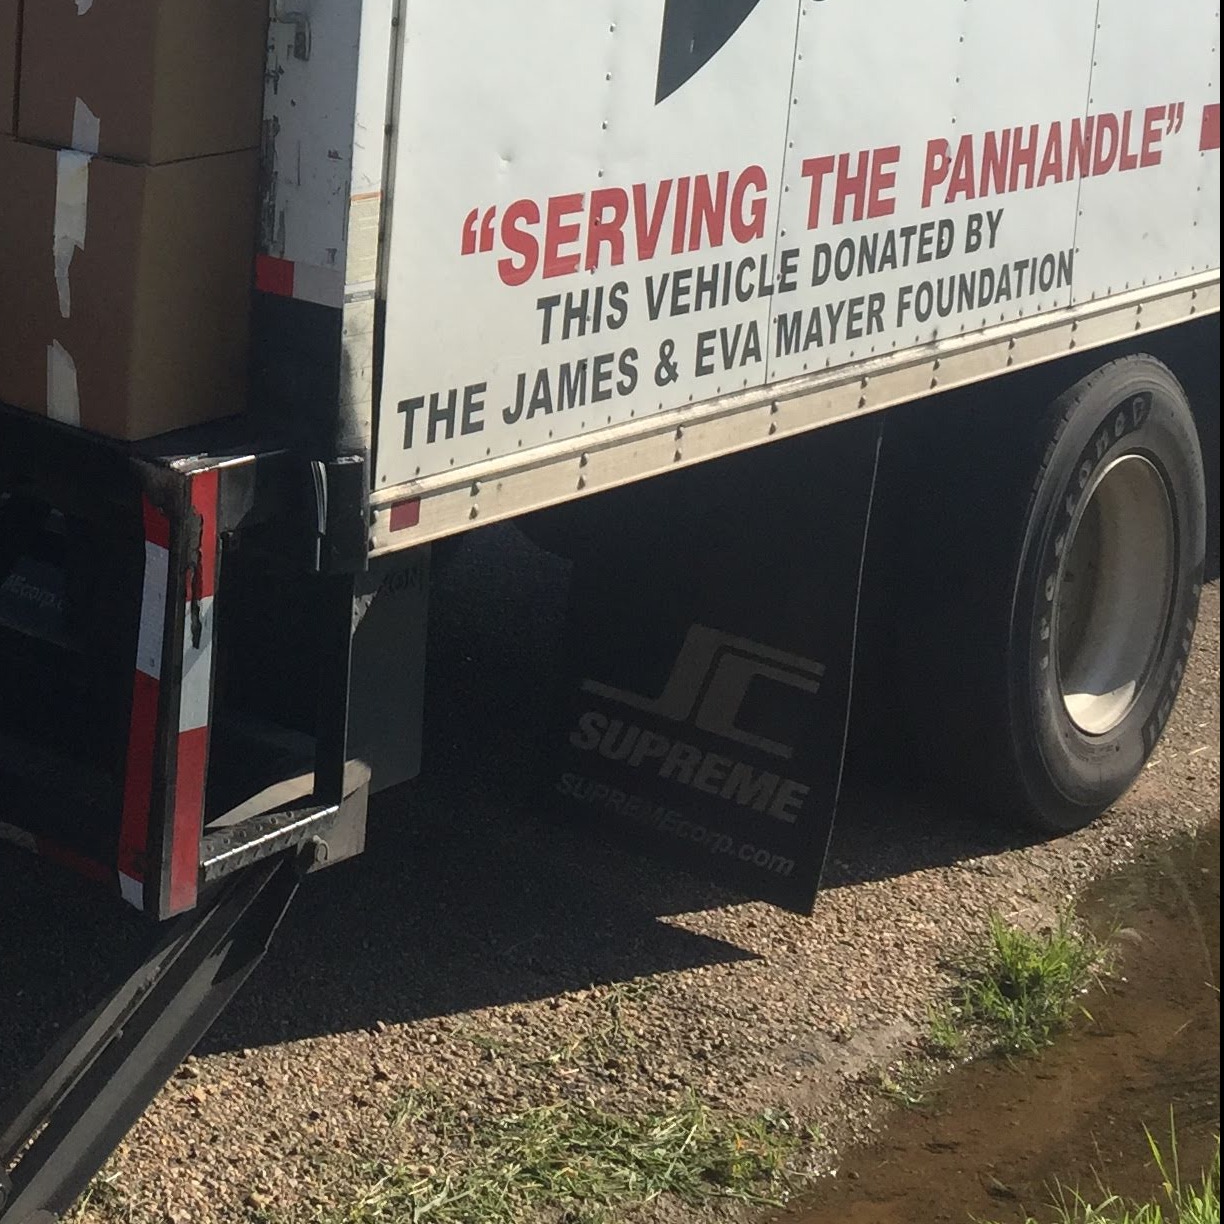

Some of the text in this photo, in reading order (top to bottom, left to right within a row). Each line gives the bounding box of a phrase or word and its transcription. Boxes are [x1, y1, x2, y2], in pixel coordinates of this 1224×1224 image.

[801, 146, 900, 230] THE
[536, 209, 1004, 345] THIS VEHICLE DONATED BY
[397, 249, 1075, 450] THE JAMES & EVA MAYER FOUNDATION
[570, 710, 812, 825] SUPREME
